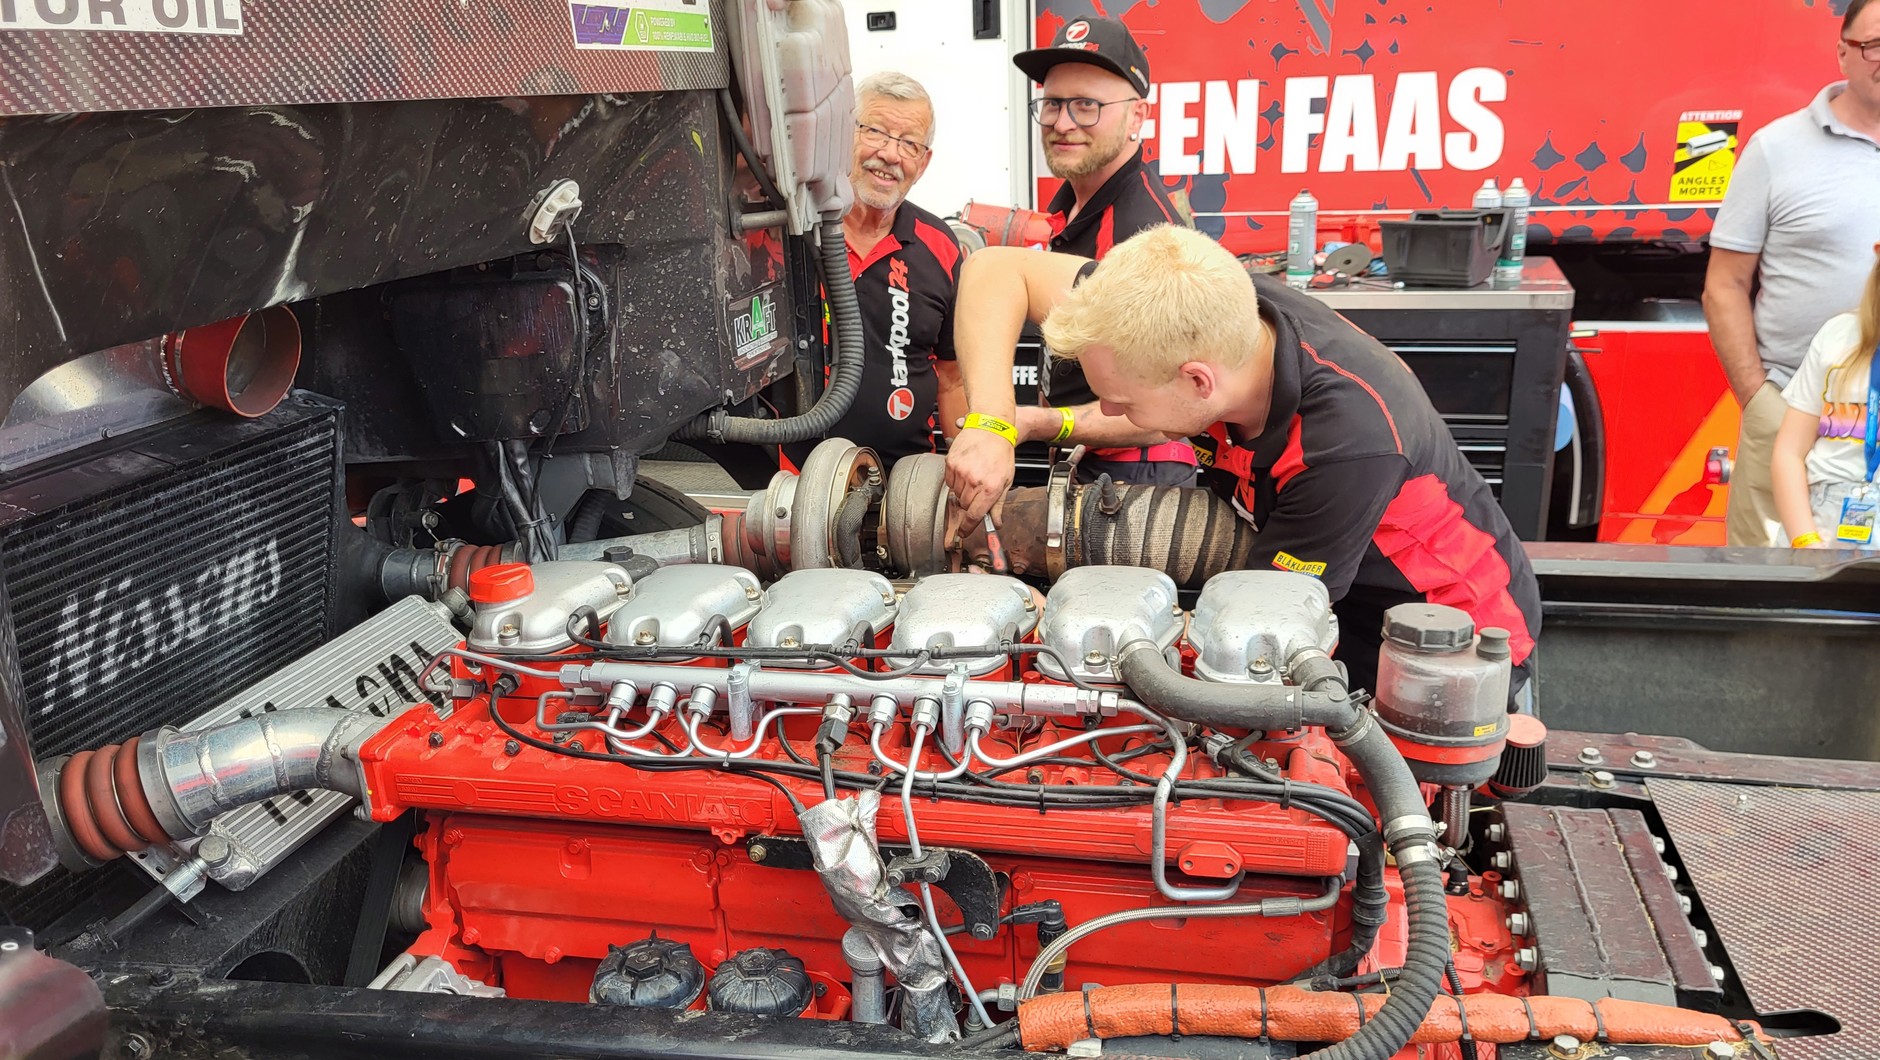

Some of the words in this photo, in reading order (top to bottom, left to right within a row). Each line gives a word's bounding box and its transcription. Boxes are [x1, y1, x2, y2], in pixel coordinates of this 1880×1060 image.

[1281, 67, 1507, 173] FAAS
[1679, 110, 1743, 121] ATTENTION
[1678, 176, 1725, 186] ANGLES
[1679, 186, 1721, 196] MORTS
[734, 296, 776, 348] KRAFT
[1012, 366, 1038, 385] FFE
[555, 785, 736, 824] SCANIA
